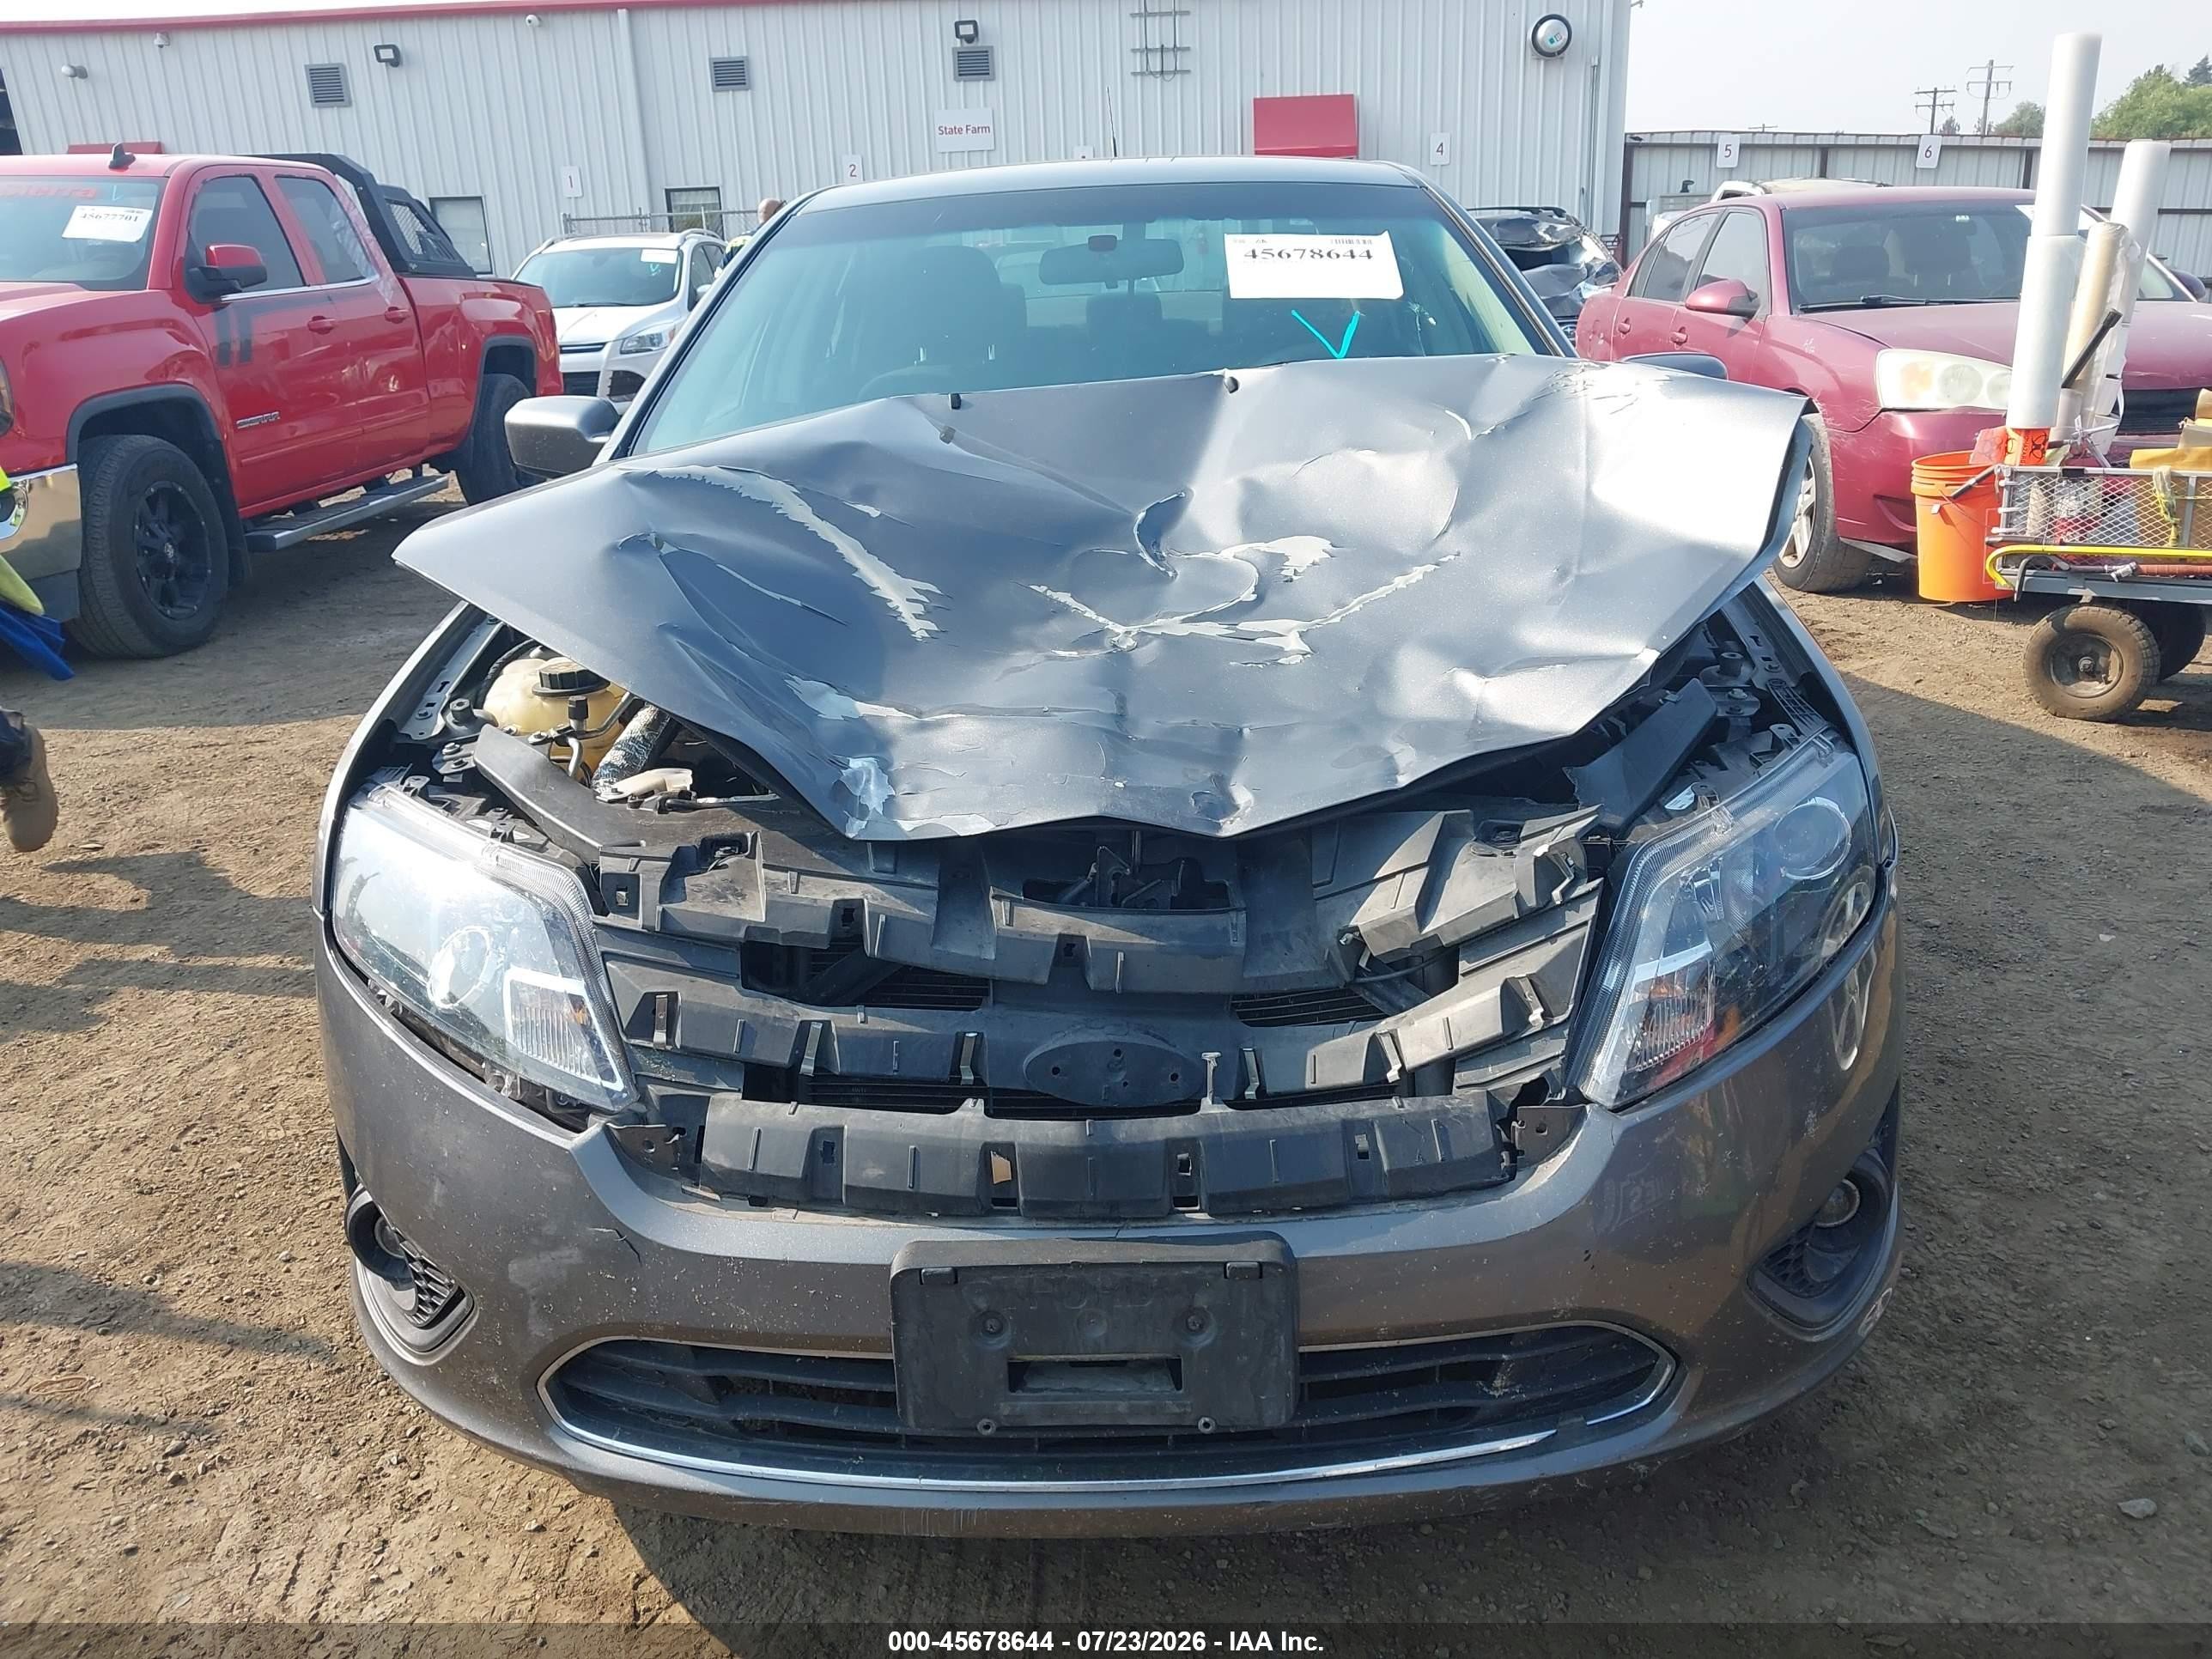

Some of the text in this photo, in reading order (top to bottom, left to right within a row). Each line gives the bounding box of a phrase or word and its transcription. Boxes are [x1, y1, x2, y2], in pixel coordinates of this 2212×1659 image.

[938, 125, 990, 136] State Farm
[1436, 142, 1443, 155] 4
[1724, 143, 1732, 158] 5
[1924, 144, 1932, 159] 6
[848, 163, 857, 178] 2
[1243, 248, 1373, 260] 45678644
